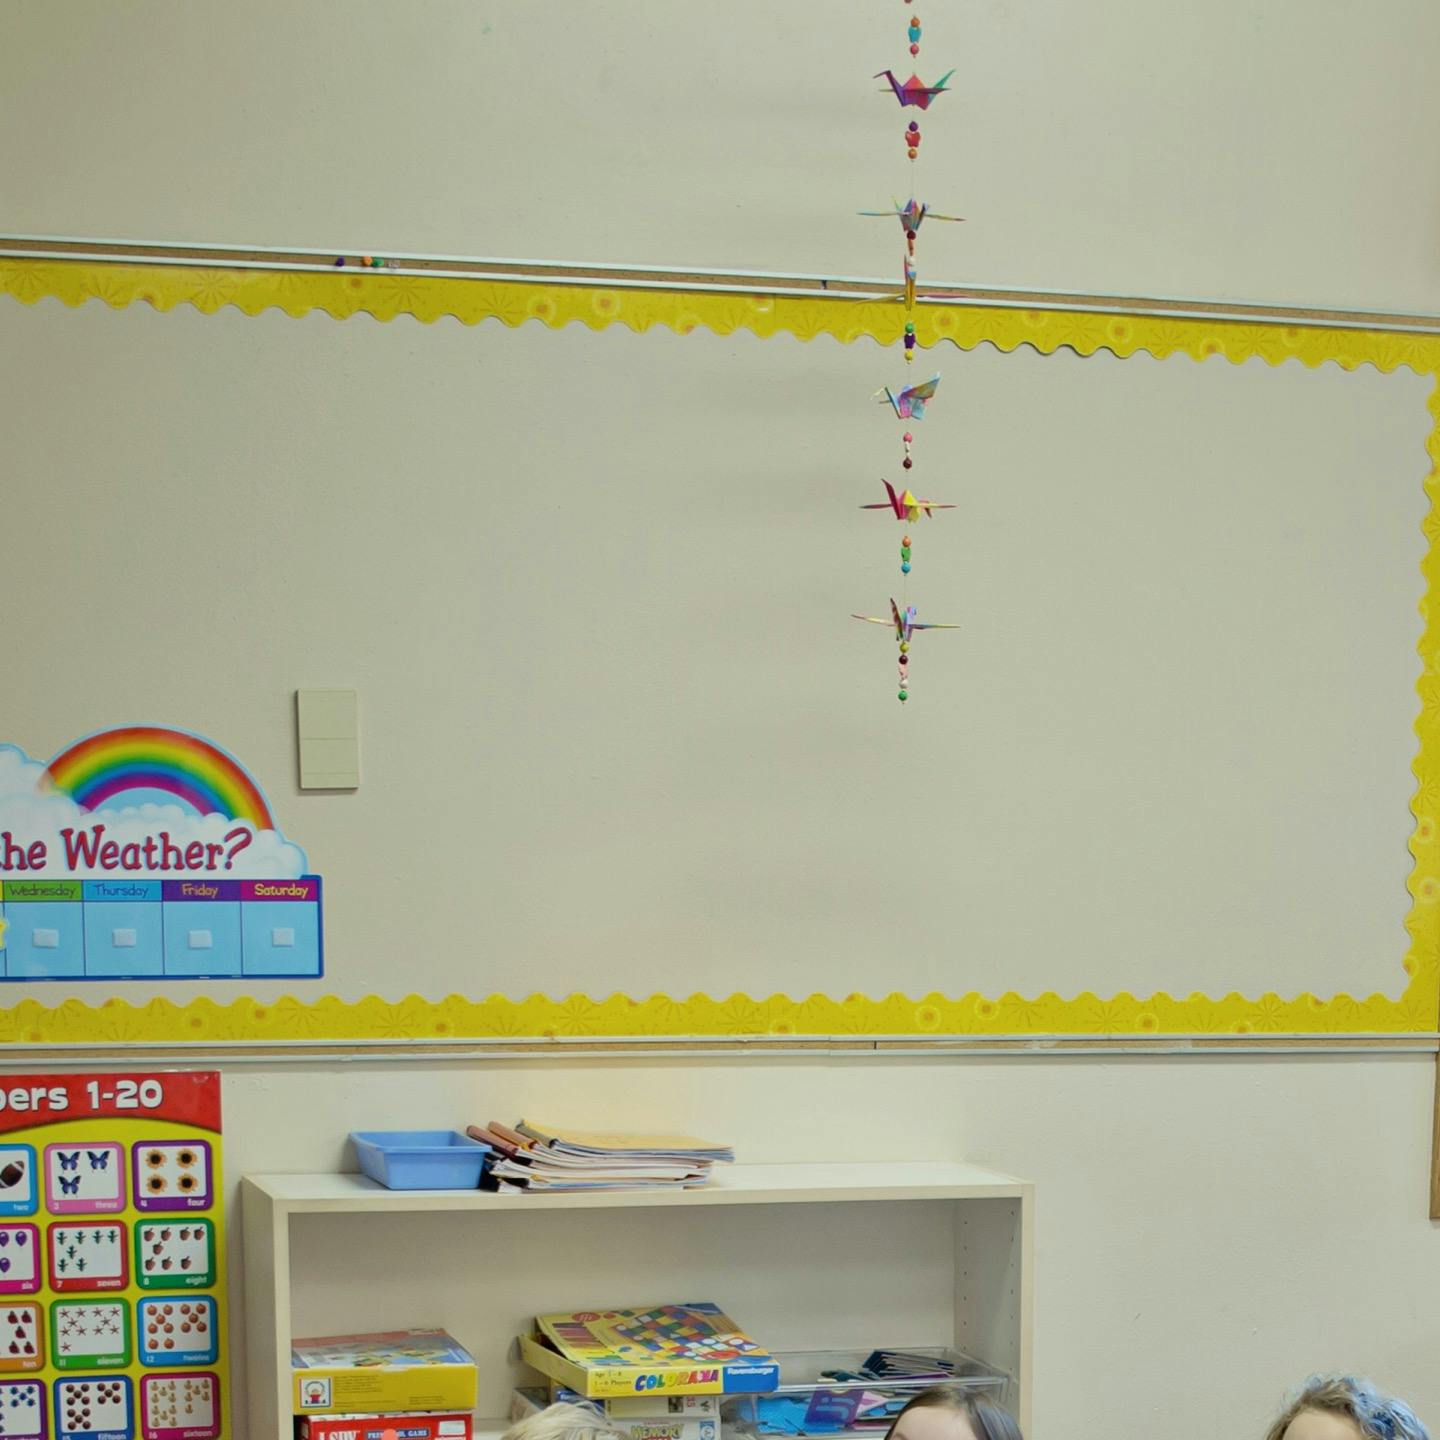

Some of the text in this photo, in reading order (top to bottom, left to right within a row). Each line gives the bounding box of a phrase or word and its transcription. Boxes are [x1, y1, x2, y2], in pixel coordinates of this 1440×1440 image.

[60, 824, 253, 872] Weather?
[10, 882, 77, 898] Wednesday
[94, 882, 149, 898] Thursday
[181, 882, 219, 898] Friday
[253, 883, 309, 899] Saturday
[87, 1079, 165, 1110] 1-20
[12, 1203, 29, 1211] two
[187, 1198, 206, 1207] four
[97, 1279, 121, 1288] seven
[185, 1275, 208, 1286] eight
[96, 1357, 124, 1366] eleven
[146, 1355, 156, 1364] 12
[634, 1369, 720, 1392] COLORAMA
[148, 1430, 158, 1440] 16
